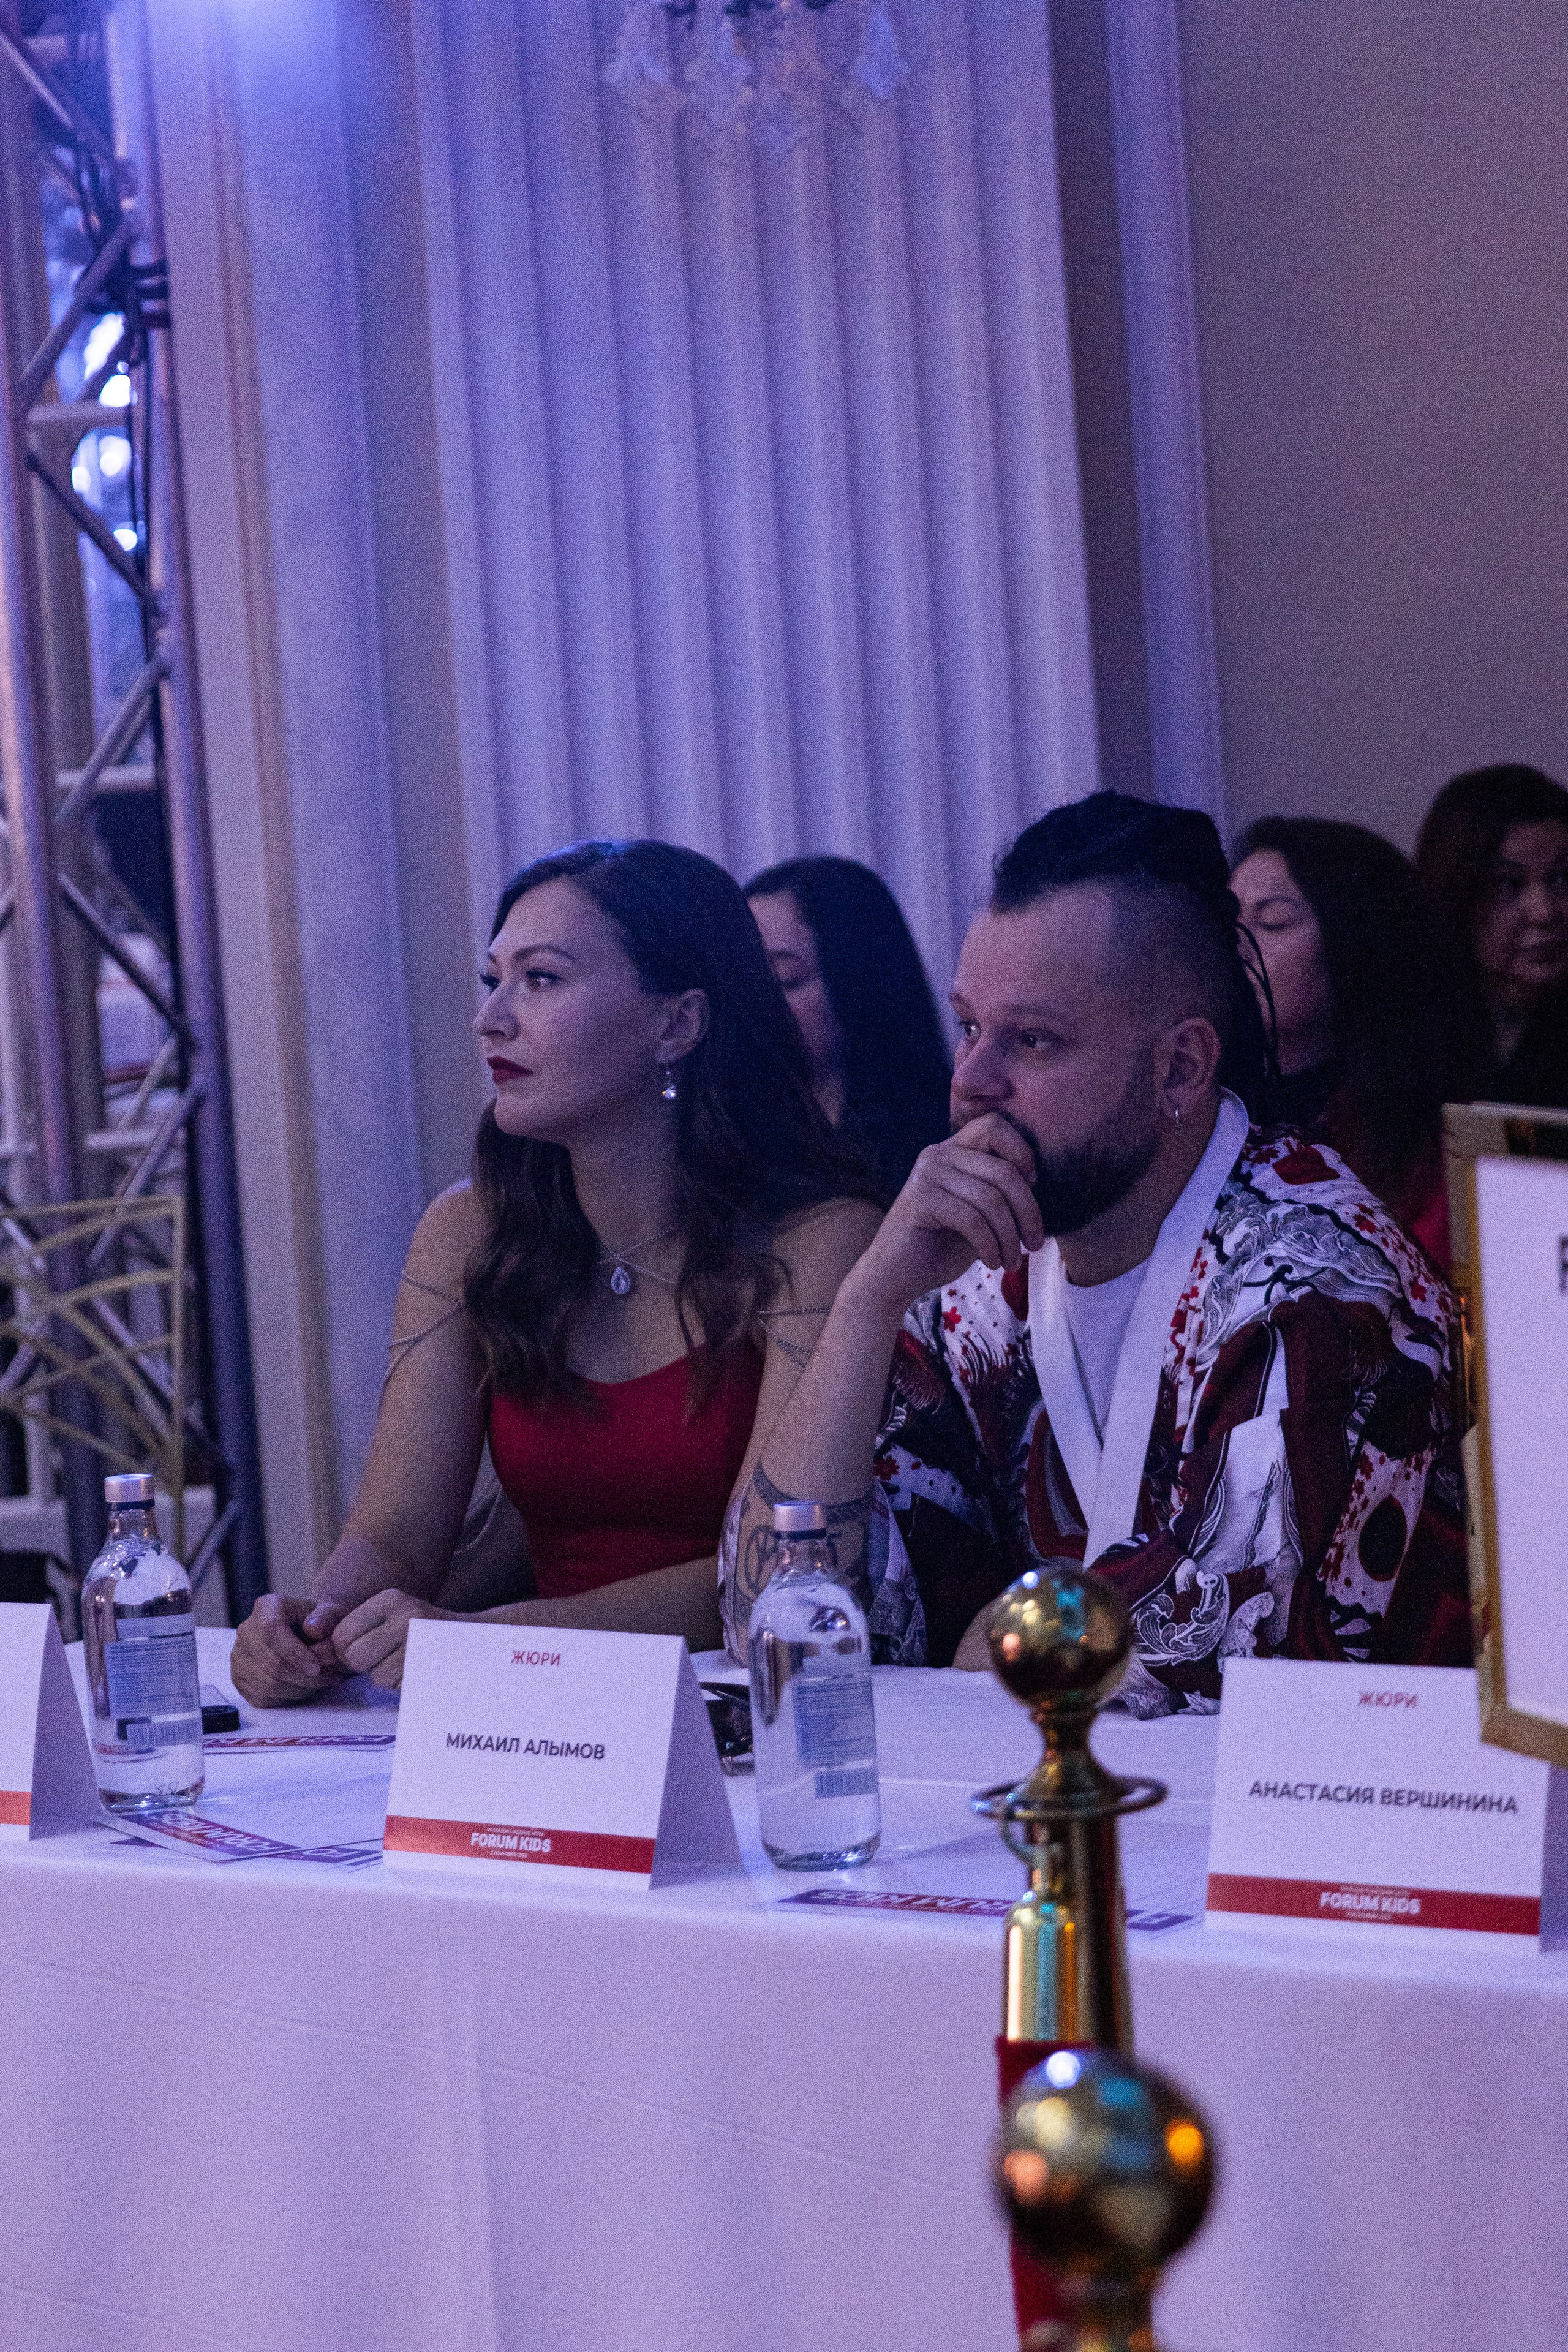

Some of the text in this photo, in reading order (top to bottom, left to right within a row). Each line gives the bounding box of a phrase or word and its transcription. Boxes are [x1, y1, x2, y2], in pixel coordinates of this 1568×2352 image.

[511, 1649, 562, 1667] ЖЮРИ
[1357, 1690, 1419, 1708] ЖЮРИ
[446, 1732, 605, 1760] МИХАИЛ АЛЫМОВ
[1249, 1780, 1520, 1814] АНАСТАСИЯ ВЕРШИНИНА
[470, 1832, 552, 1853] FORUM KIDS
[1319, 1891, 1379, 1911] FORUM
[1381, 1896, 1422, 1915] KIDS
